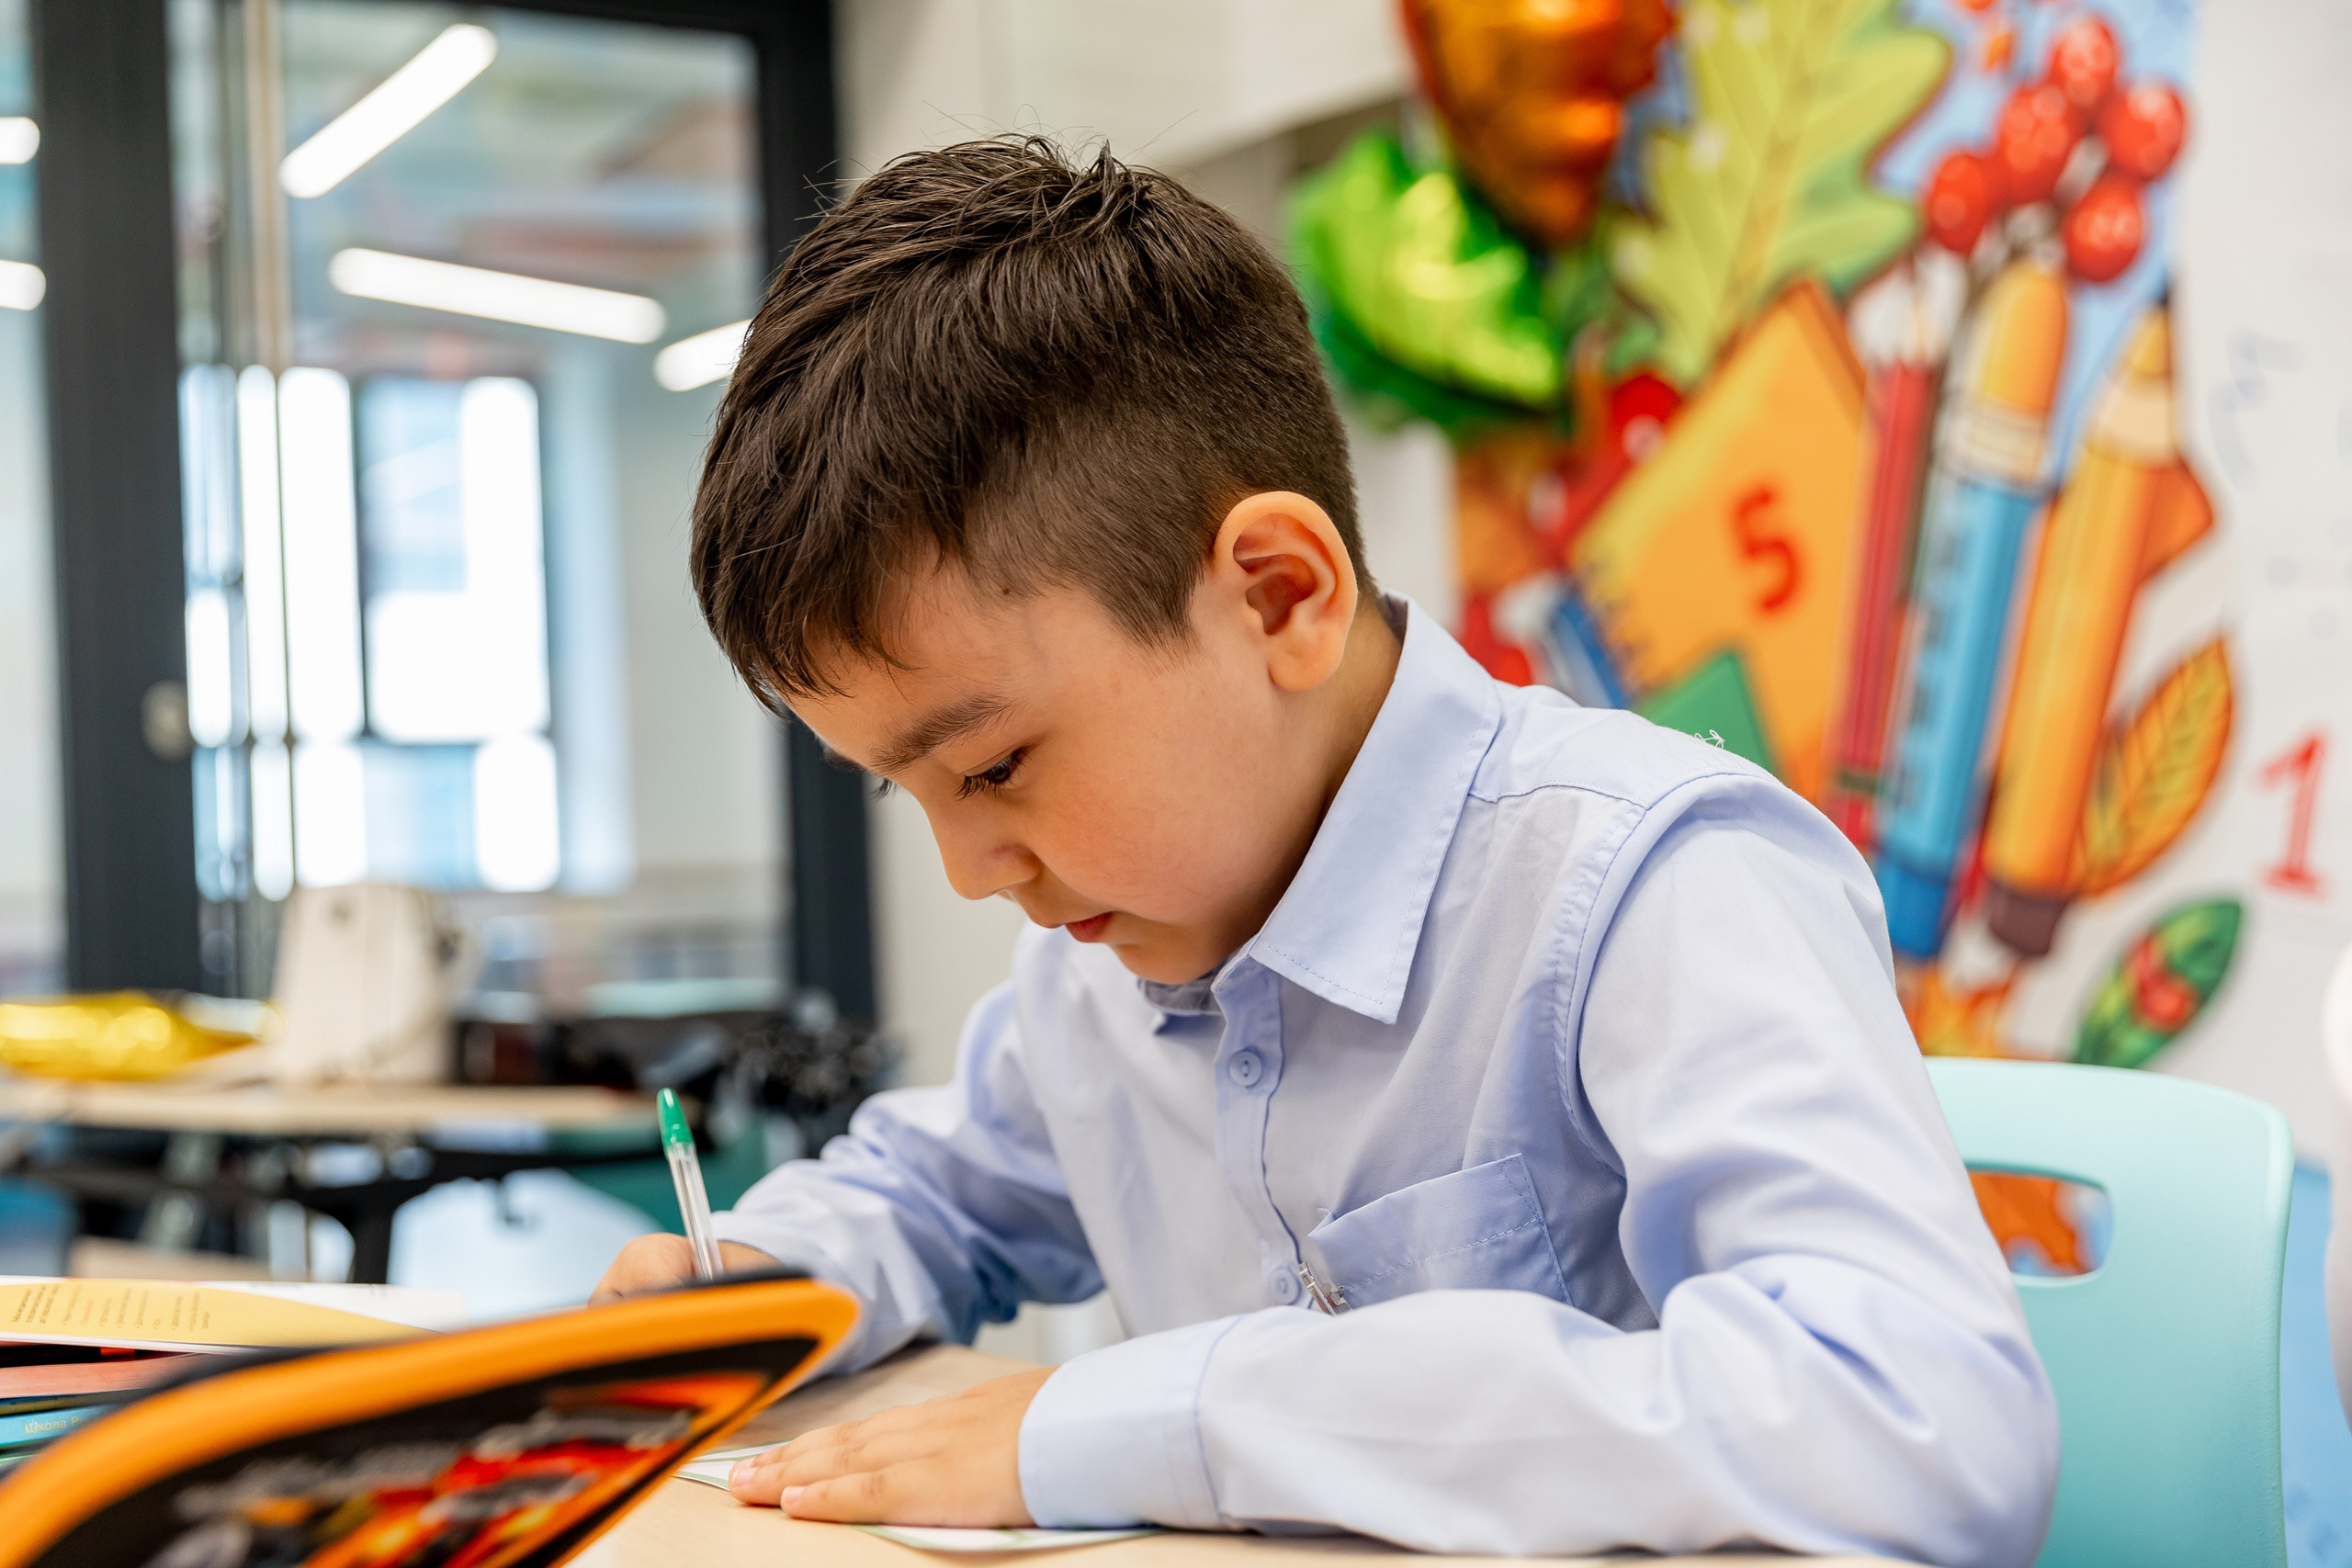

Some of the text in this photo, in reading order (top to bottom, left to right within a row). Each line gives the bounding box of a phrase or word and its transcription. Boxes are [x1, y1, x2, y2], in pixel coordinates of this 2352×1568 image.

[1727, 486, 1801, 615] 5
[2257, 733, 2333, 901] 1
[24, 1420, 67, 1434] Школа
